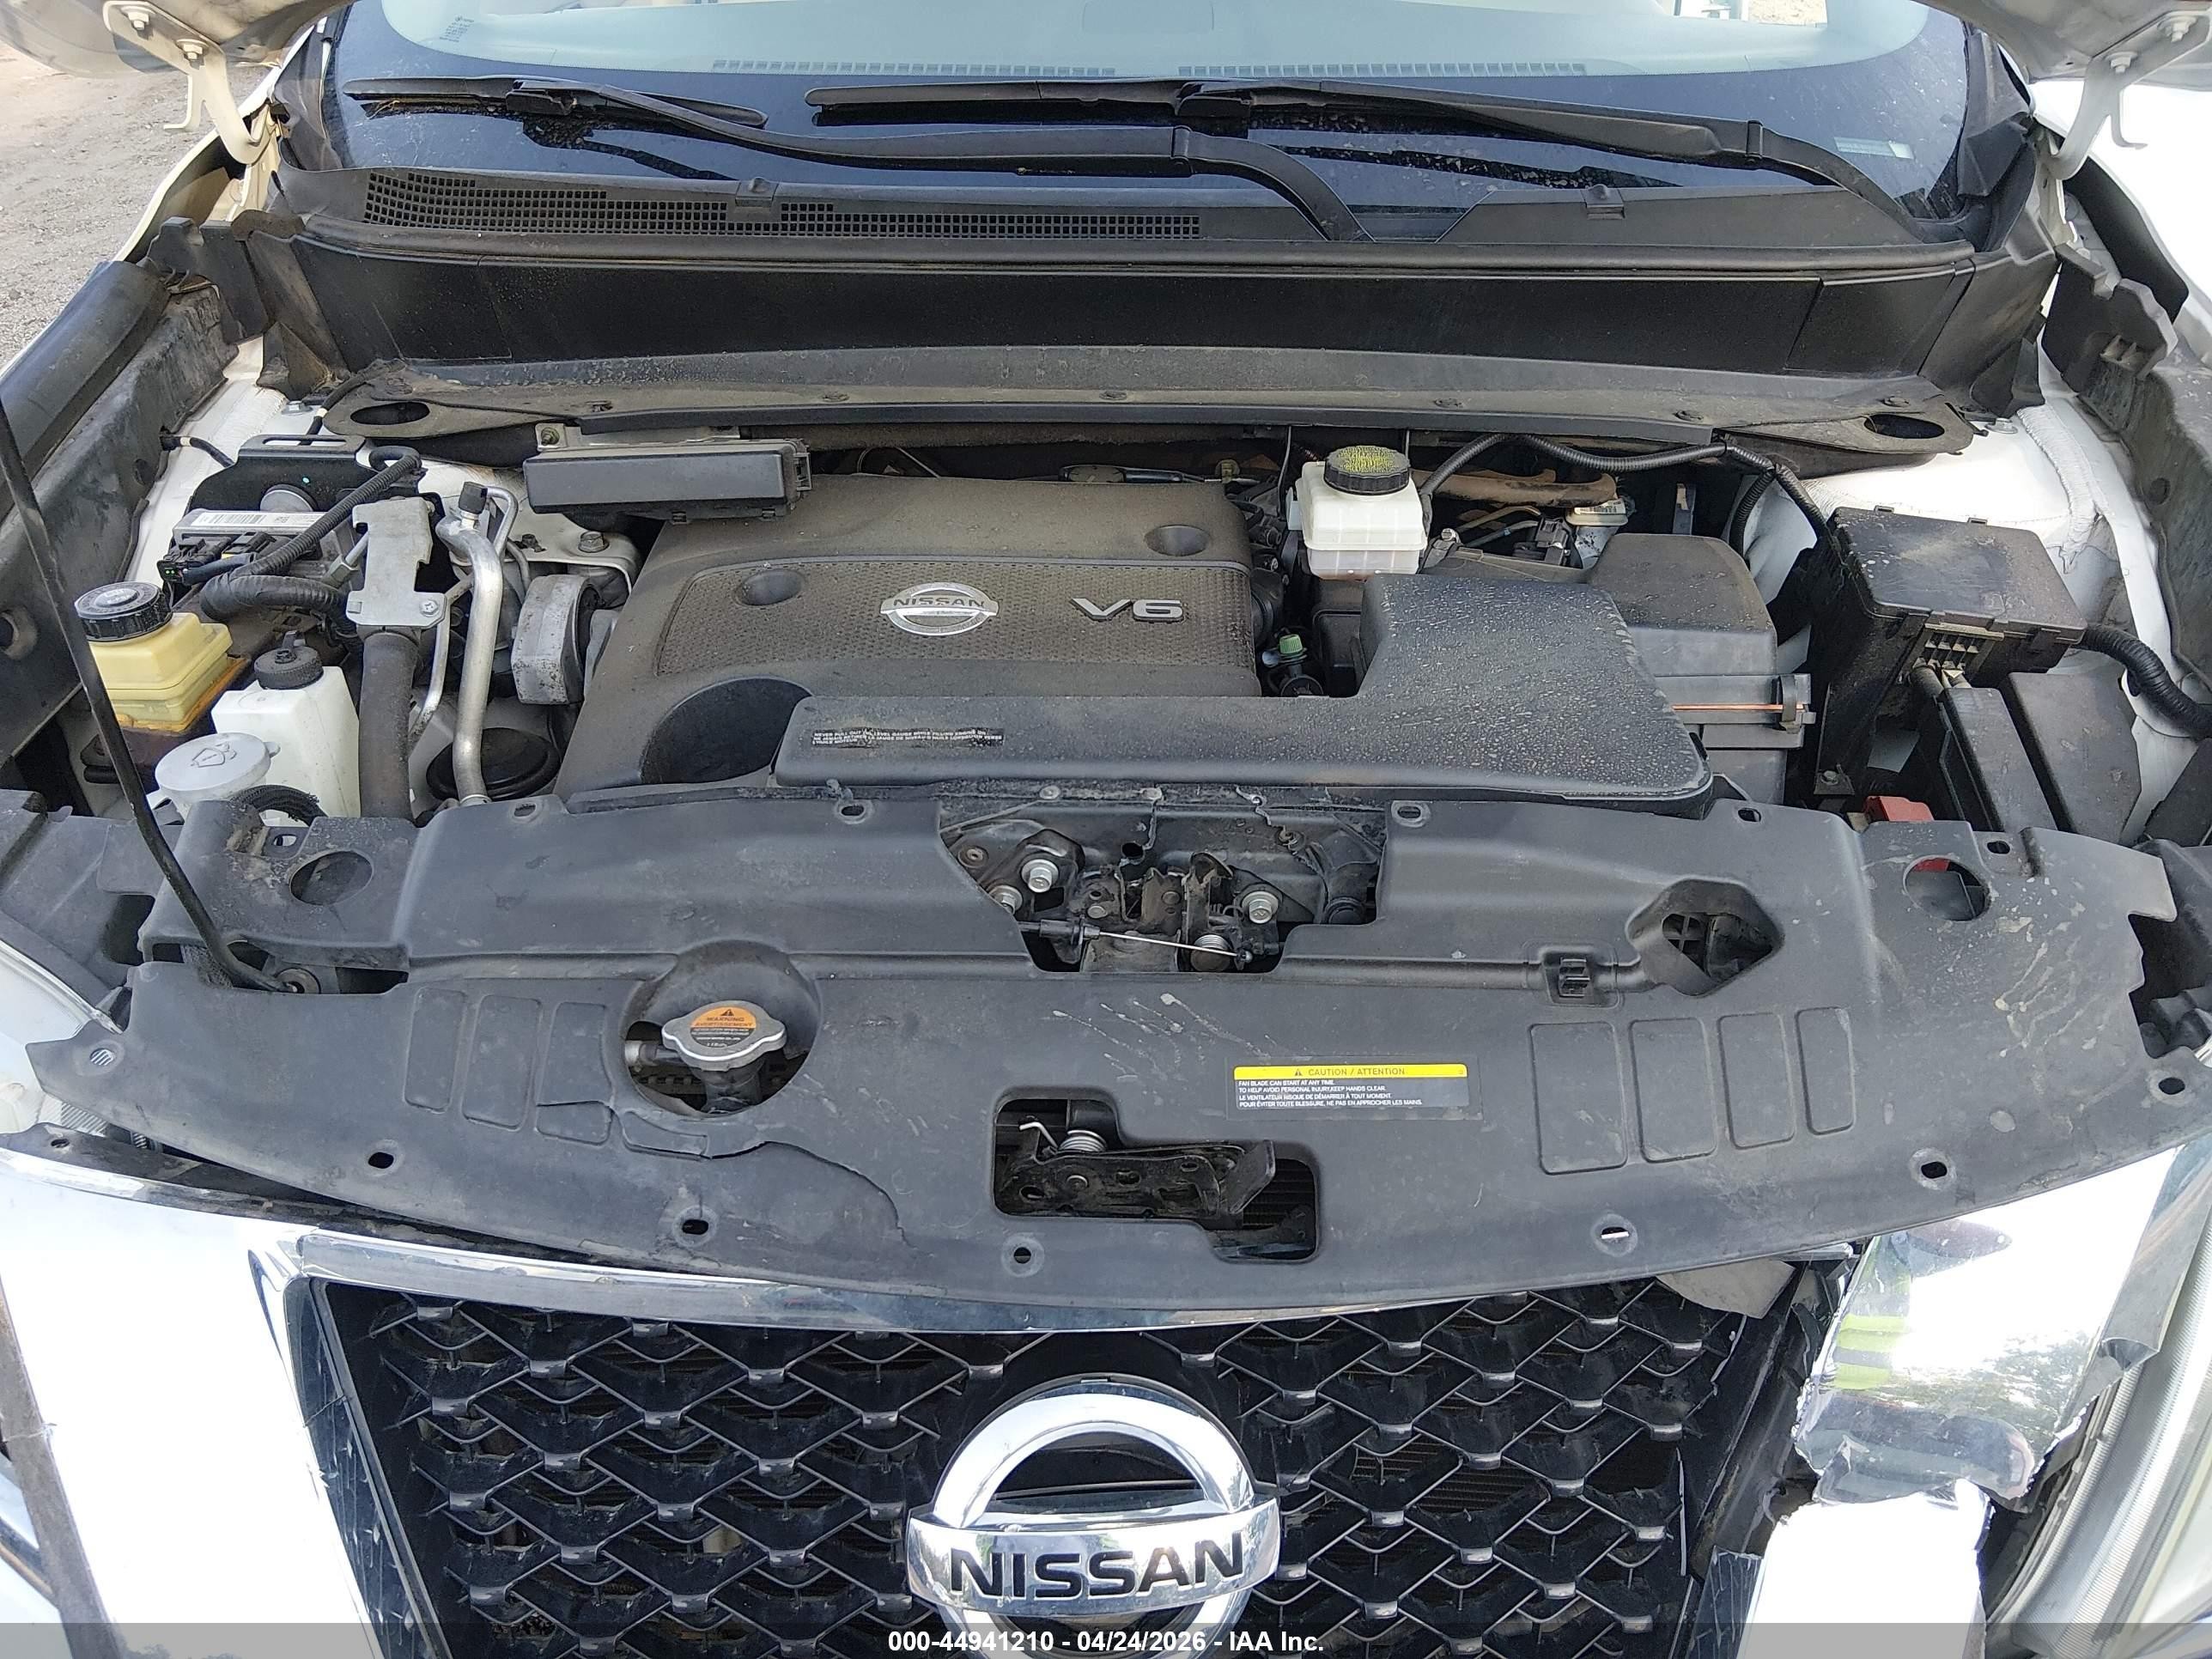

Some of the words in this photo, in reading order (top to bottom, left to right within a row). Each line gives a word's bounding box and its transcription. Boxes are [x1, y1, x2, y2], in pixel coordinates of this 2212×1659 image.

[893, 597, 985, 607] NISSAN
[1072, 598, 1183, 622] V6
[949, 1530, 1244, 1599] NISSAN
